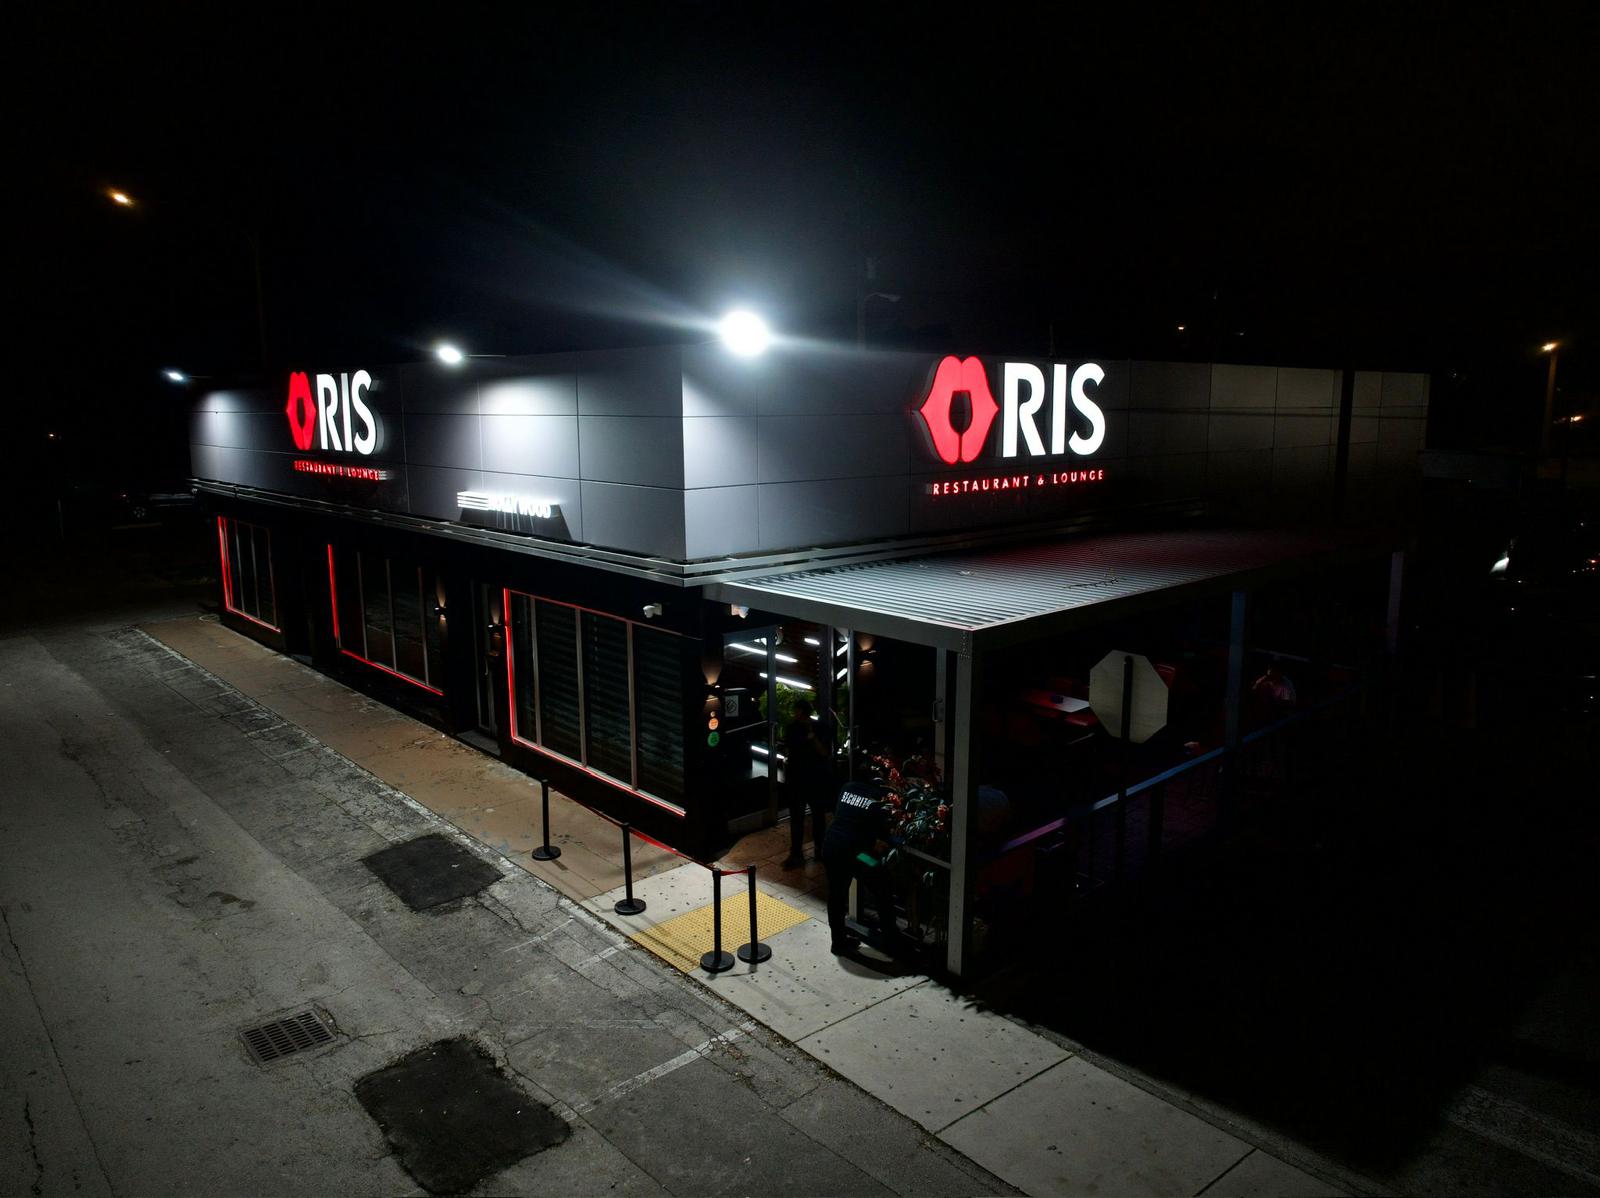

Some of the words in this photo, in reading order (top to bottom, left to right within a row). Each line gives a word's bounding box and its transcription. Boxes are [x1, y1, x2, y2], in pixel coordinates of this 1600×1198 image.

[347, 467, 379, 481] LOUNGE
[932, 475, 1030, 495] RESTAURANT
[1037, 474, 1045, 486] &
[1053, 469, 1105, 485] LOUNGE
[840, 791, 873, 810] SECURITY
